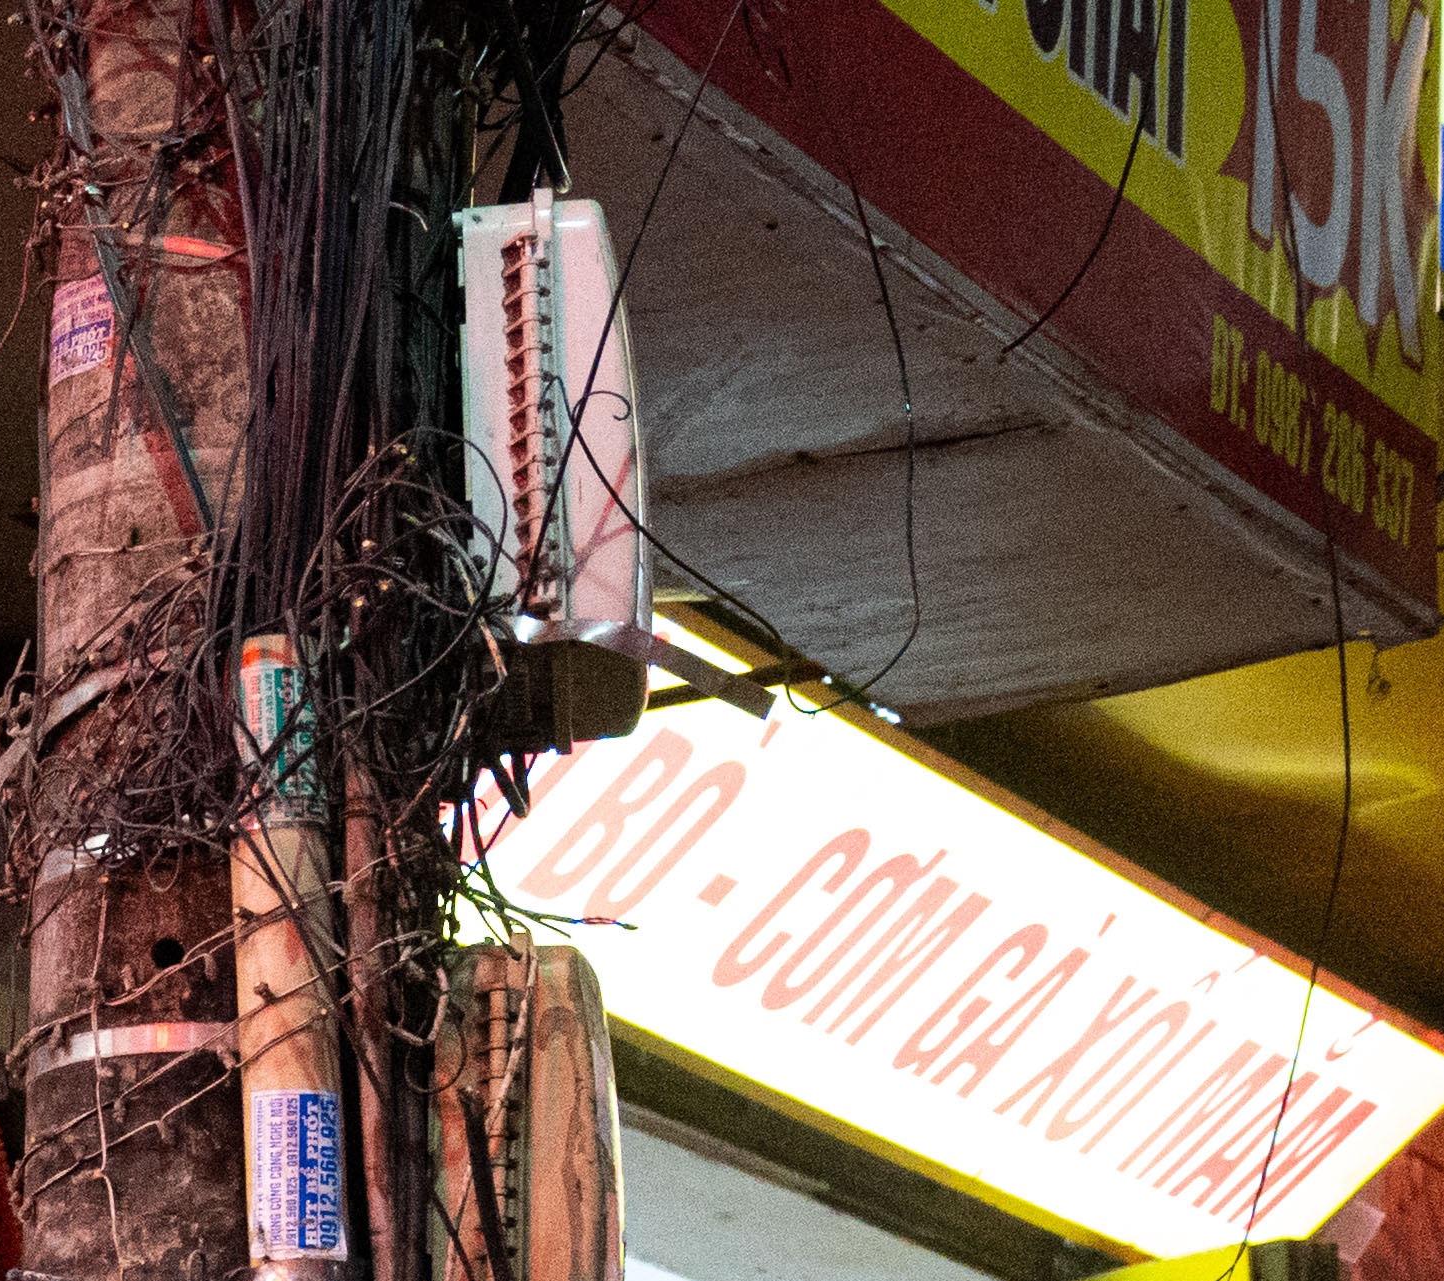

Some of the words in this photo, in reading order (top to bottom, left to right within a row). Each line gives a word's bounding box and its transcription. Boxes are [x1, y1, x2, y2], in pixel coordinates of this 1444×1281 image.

[710, 827, 992, 1047] CƠM
[891, 912, 1117, 1100] GÀ
[319, 1098, 339, 1248] 0912.560.925
